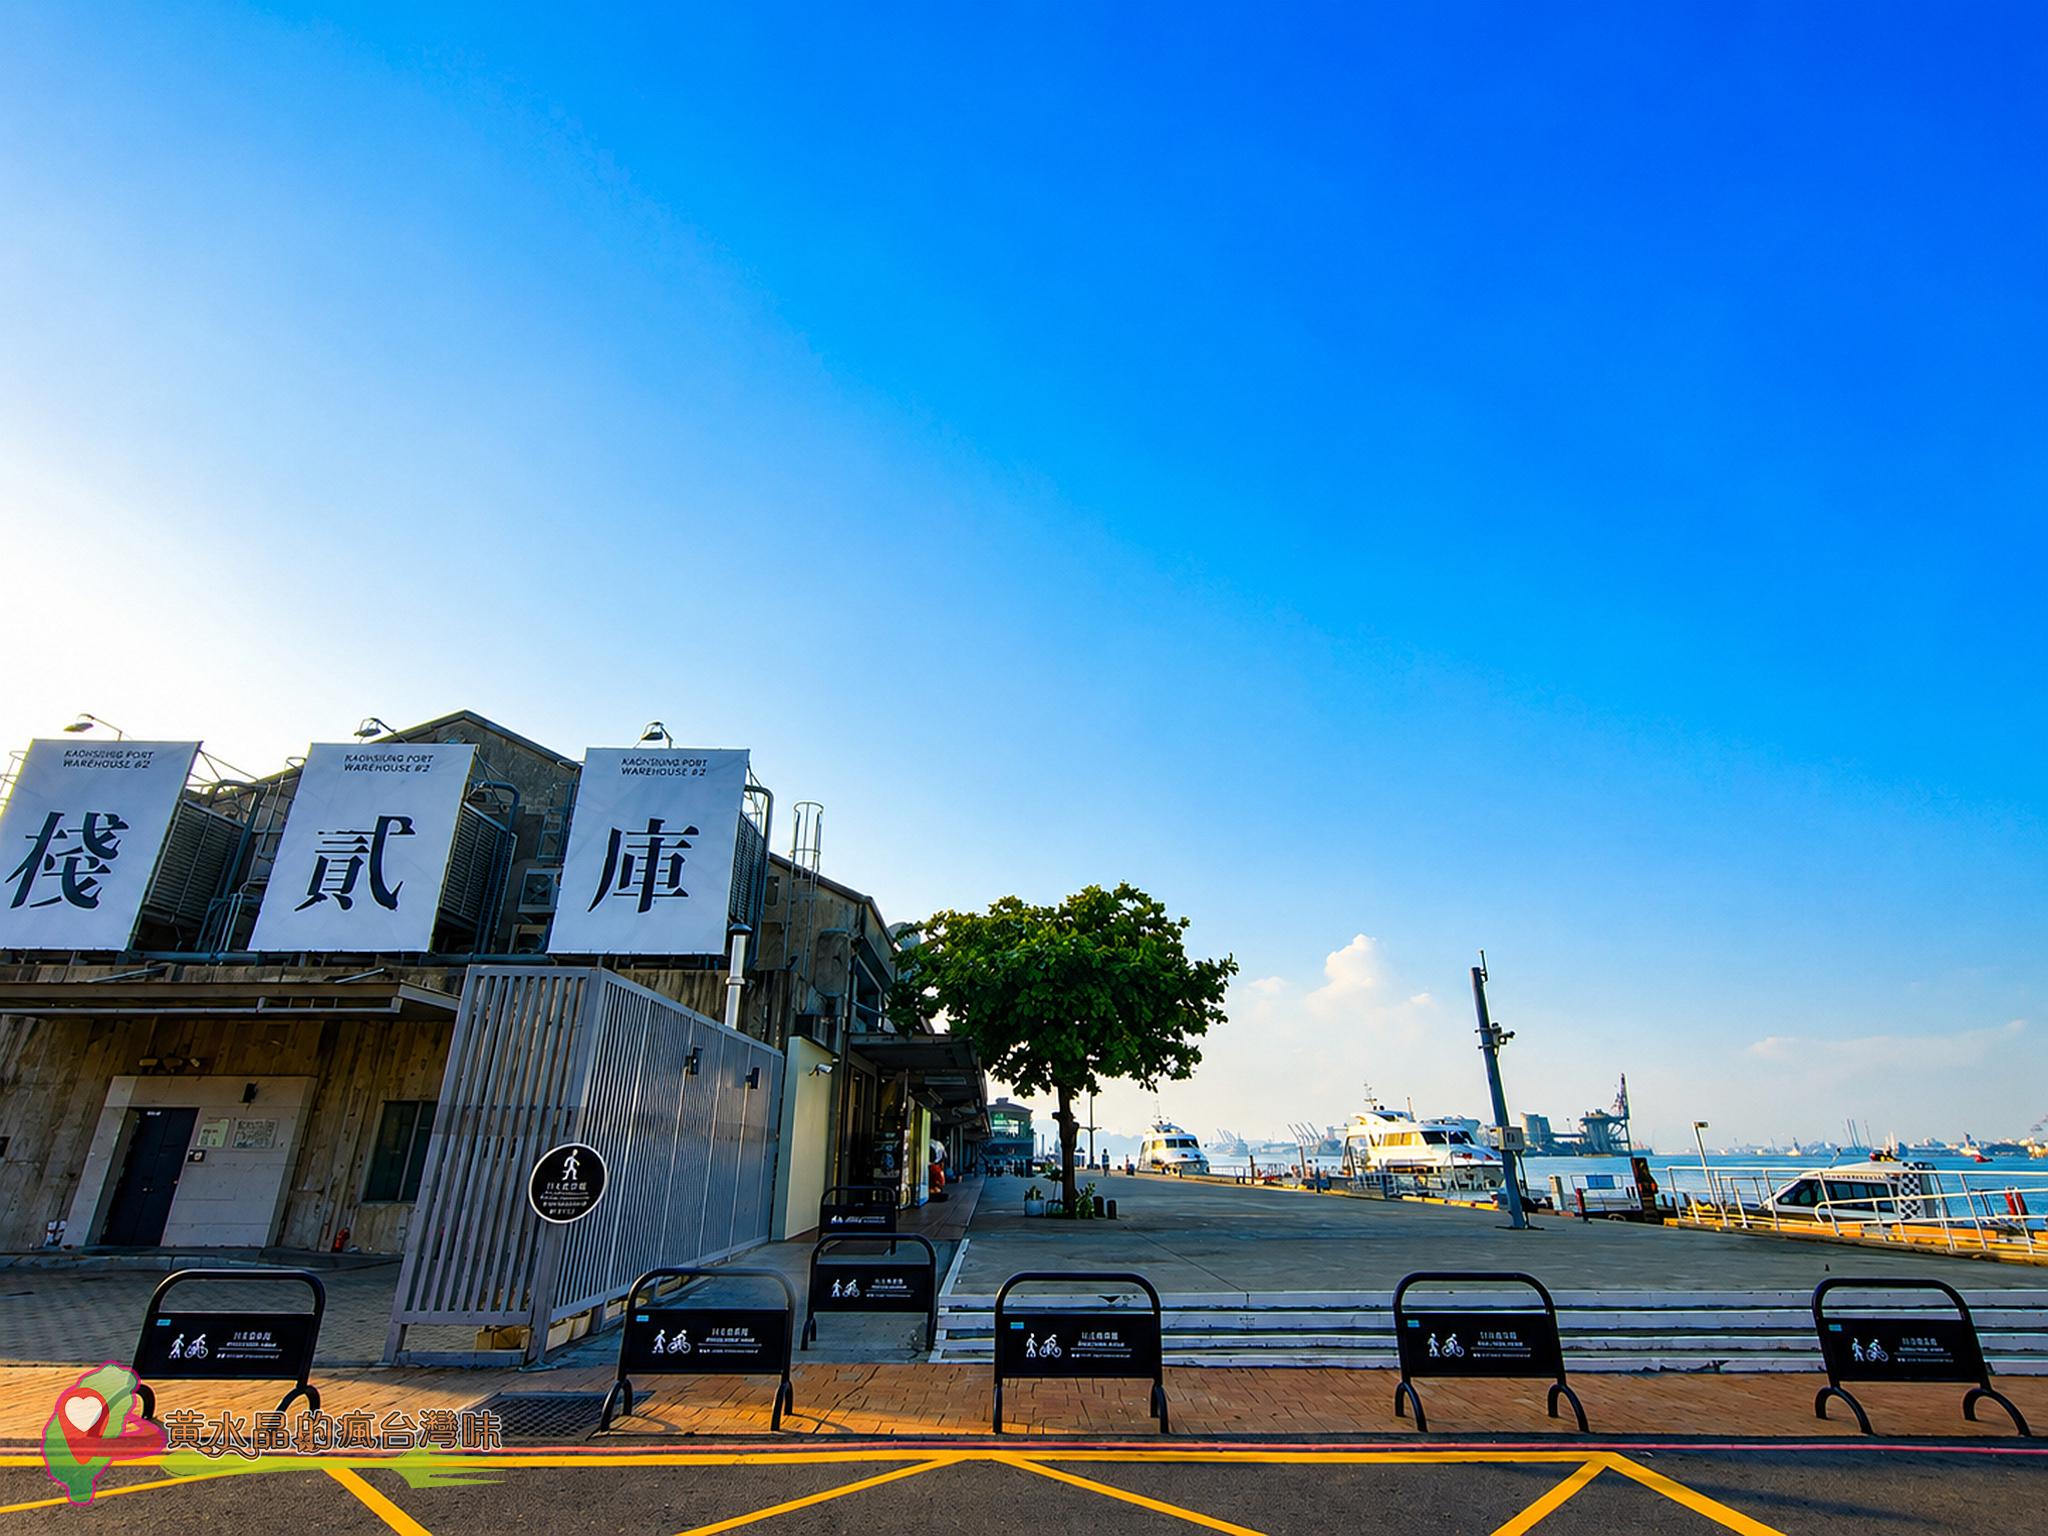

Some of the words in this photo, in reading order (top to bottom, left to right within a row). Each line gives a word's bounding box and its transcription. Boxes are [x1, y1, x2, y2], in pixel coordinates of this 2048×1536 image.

[63, 759, 131, 768] WAREHOUSE
[344, 763, 412, 772] WAREHOUSE
[621, 767, 688, 776] WAREHOUSE
[4, 811, 129, 909] 棧
[295, 815, 416, 911] 貳
[588, 818, 700, 913] 庫
